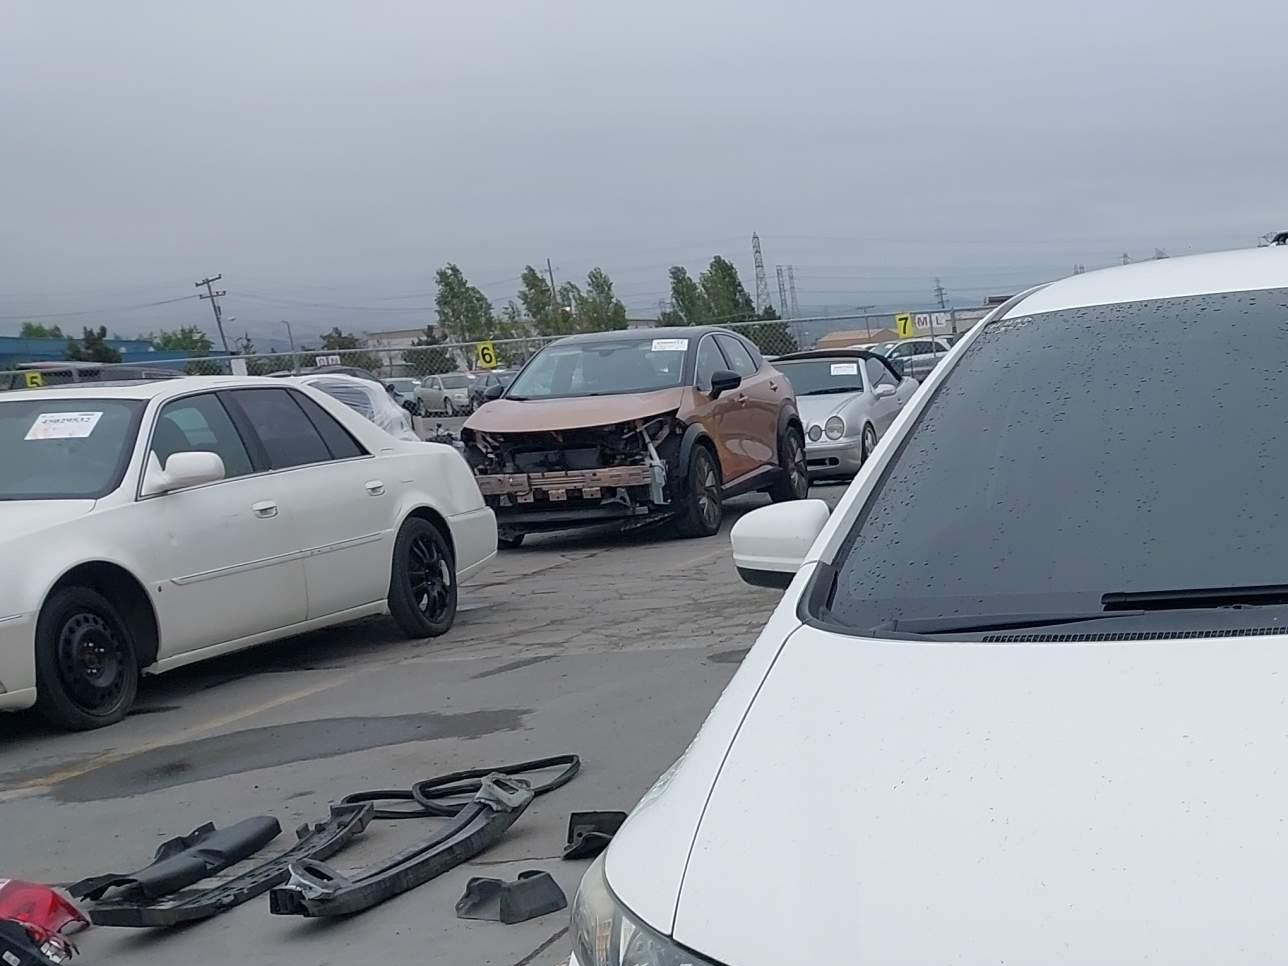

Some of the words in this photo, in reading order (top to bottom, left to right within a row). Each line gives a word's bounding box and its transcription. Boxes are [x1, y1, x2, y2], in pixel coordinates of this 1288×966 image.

[898, 316, 908, 335] 7
[480, 346, 493, 364] 6
[30, 375, 41, 387] 5
